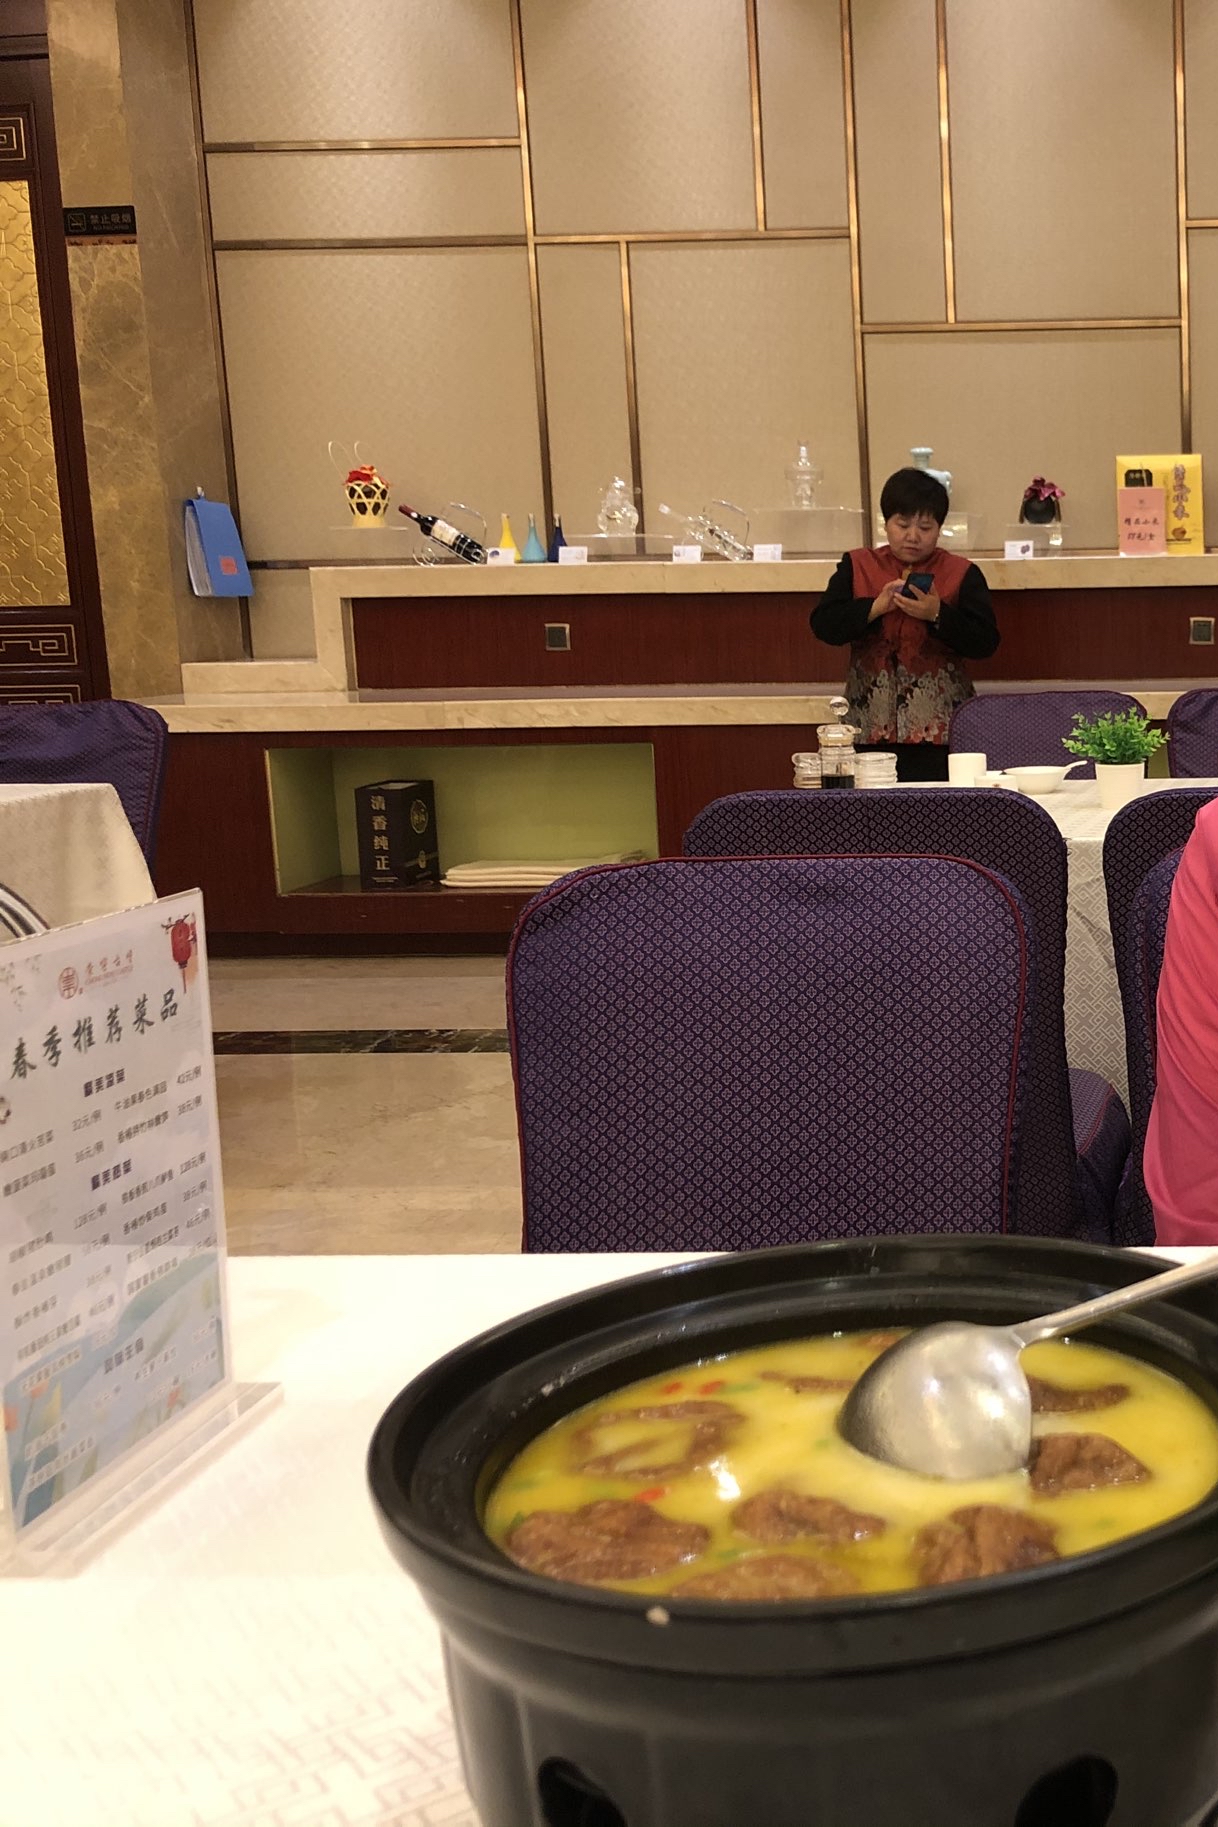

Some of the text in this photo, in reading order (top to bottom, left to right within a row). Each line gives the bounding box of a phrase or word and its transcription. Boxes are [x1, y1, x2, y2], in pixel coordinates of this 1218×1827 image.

[9, 988, 178, 1081] 春季推荐菜品
